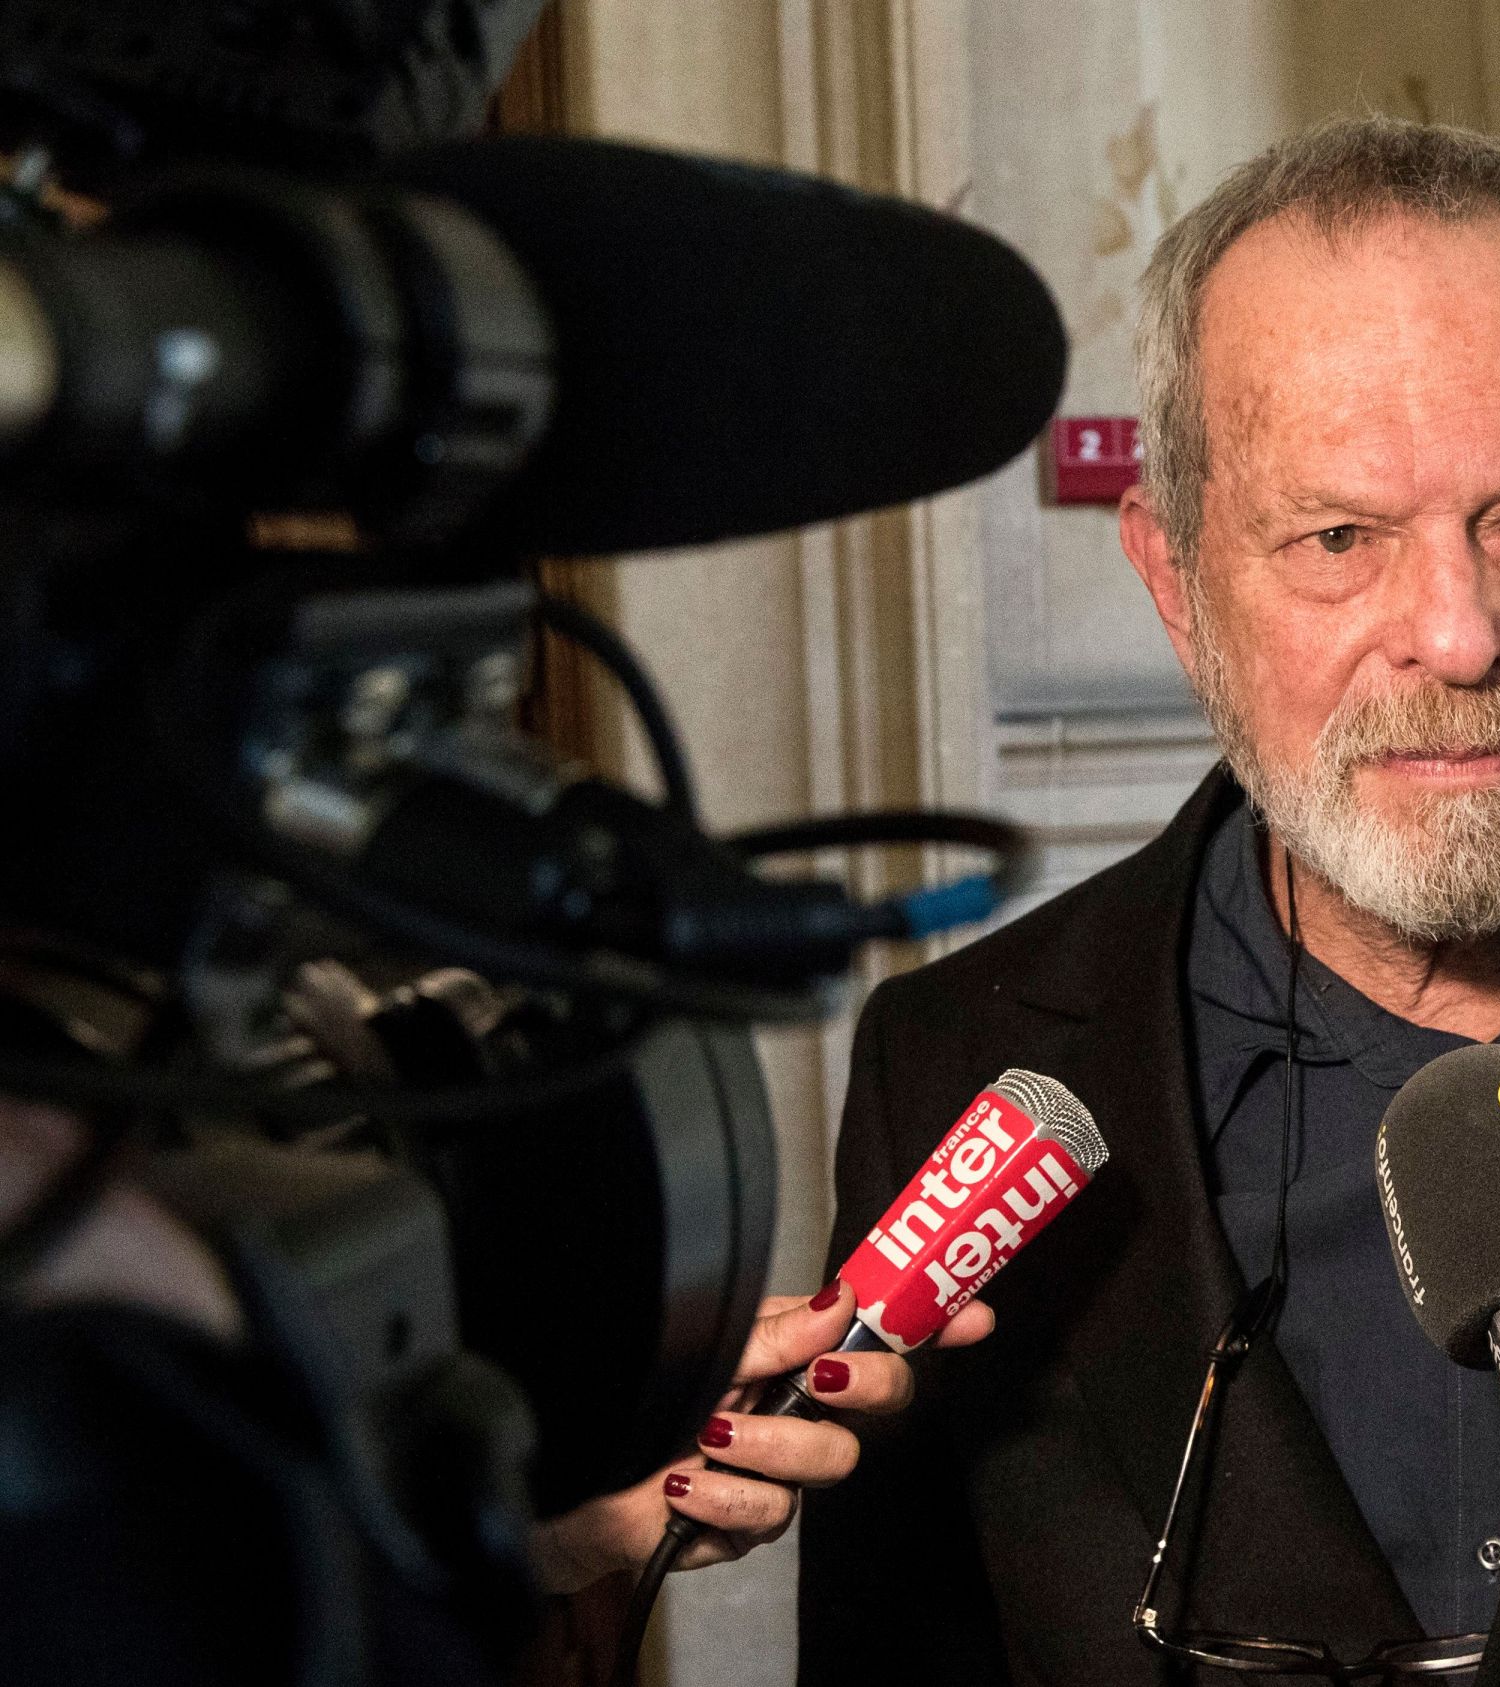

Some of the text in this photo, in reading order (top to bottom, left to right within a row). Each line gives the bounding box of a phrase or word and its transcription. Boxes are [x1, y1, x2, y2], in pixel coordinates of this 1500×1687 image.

[932, 1100, 991, 1164] france
[867, 1108, 1015, 1270] inter
[924, 1152, 1079, 1308] inter
[946, 1255, 1008, 1317] france
